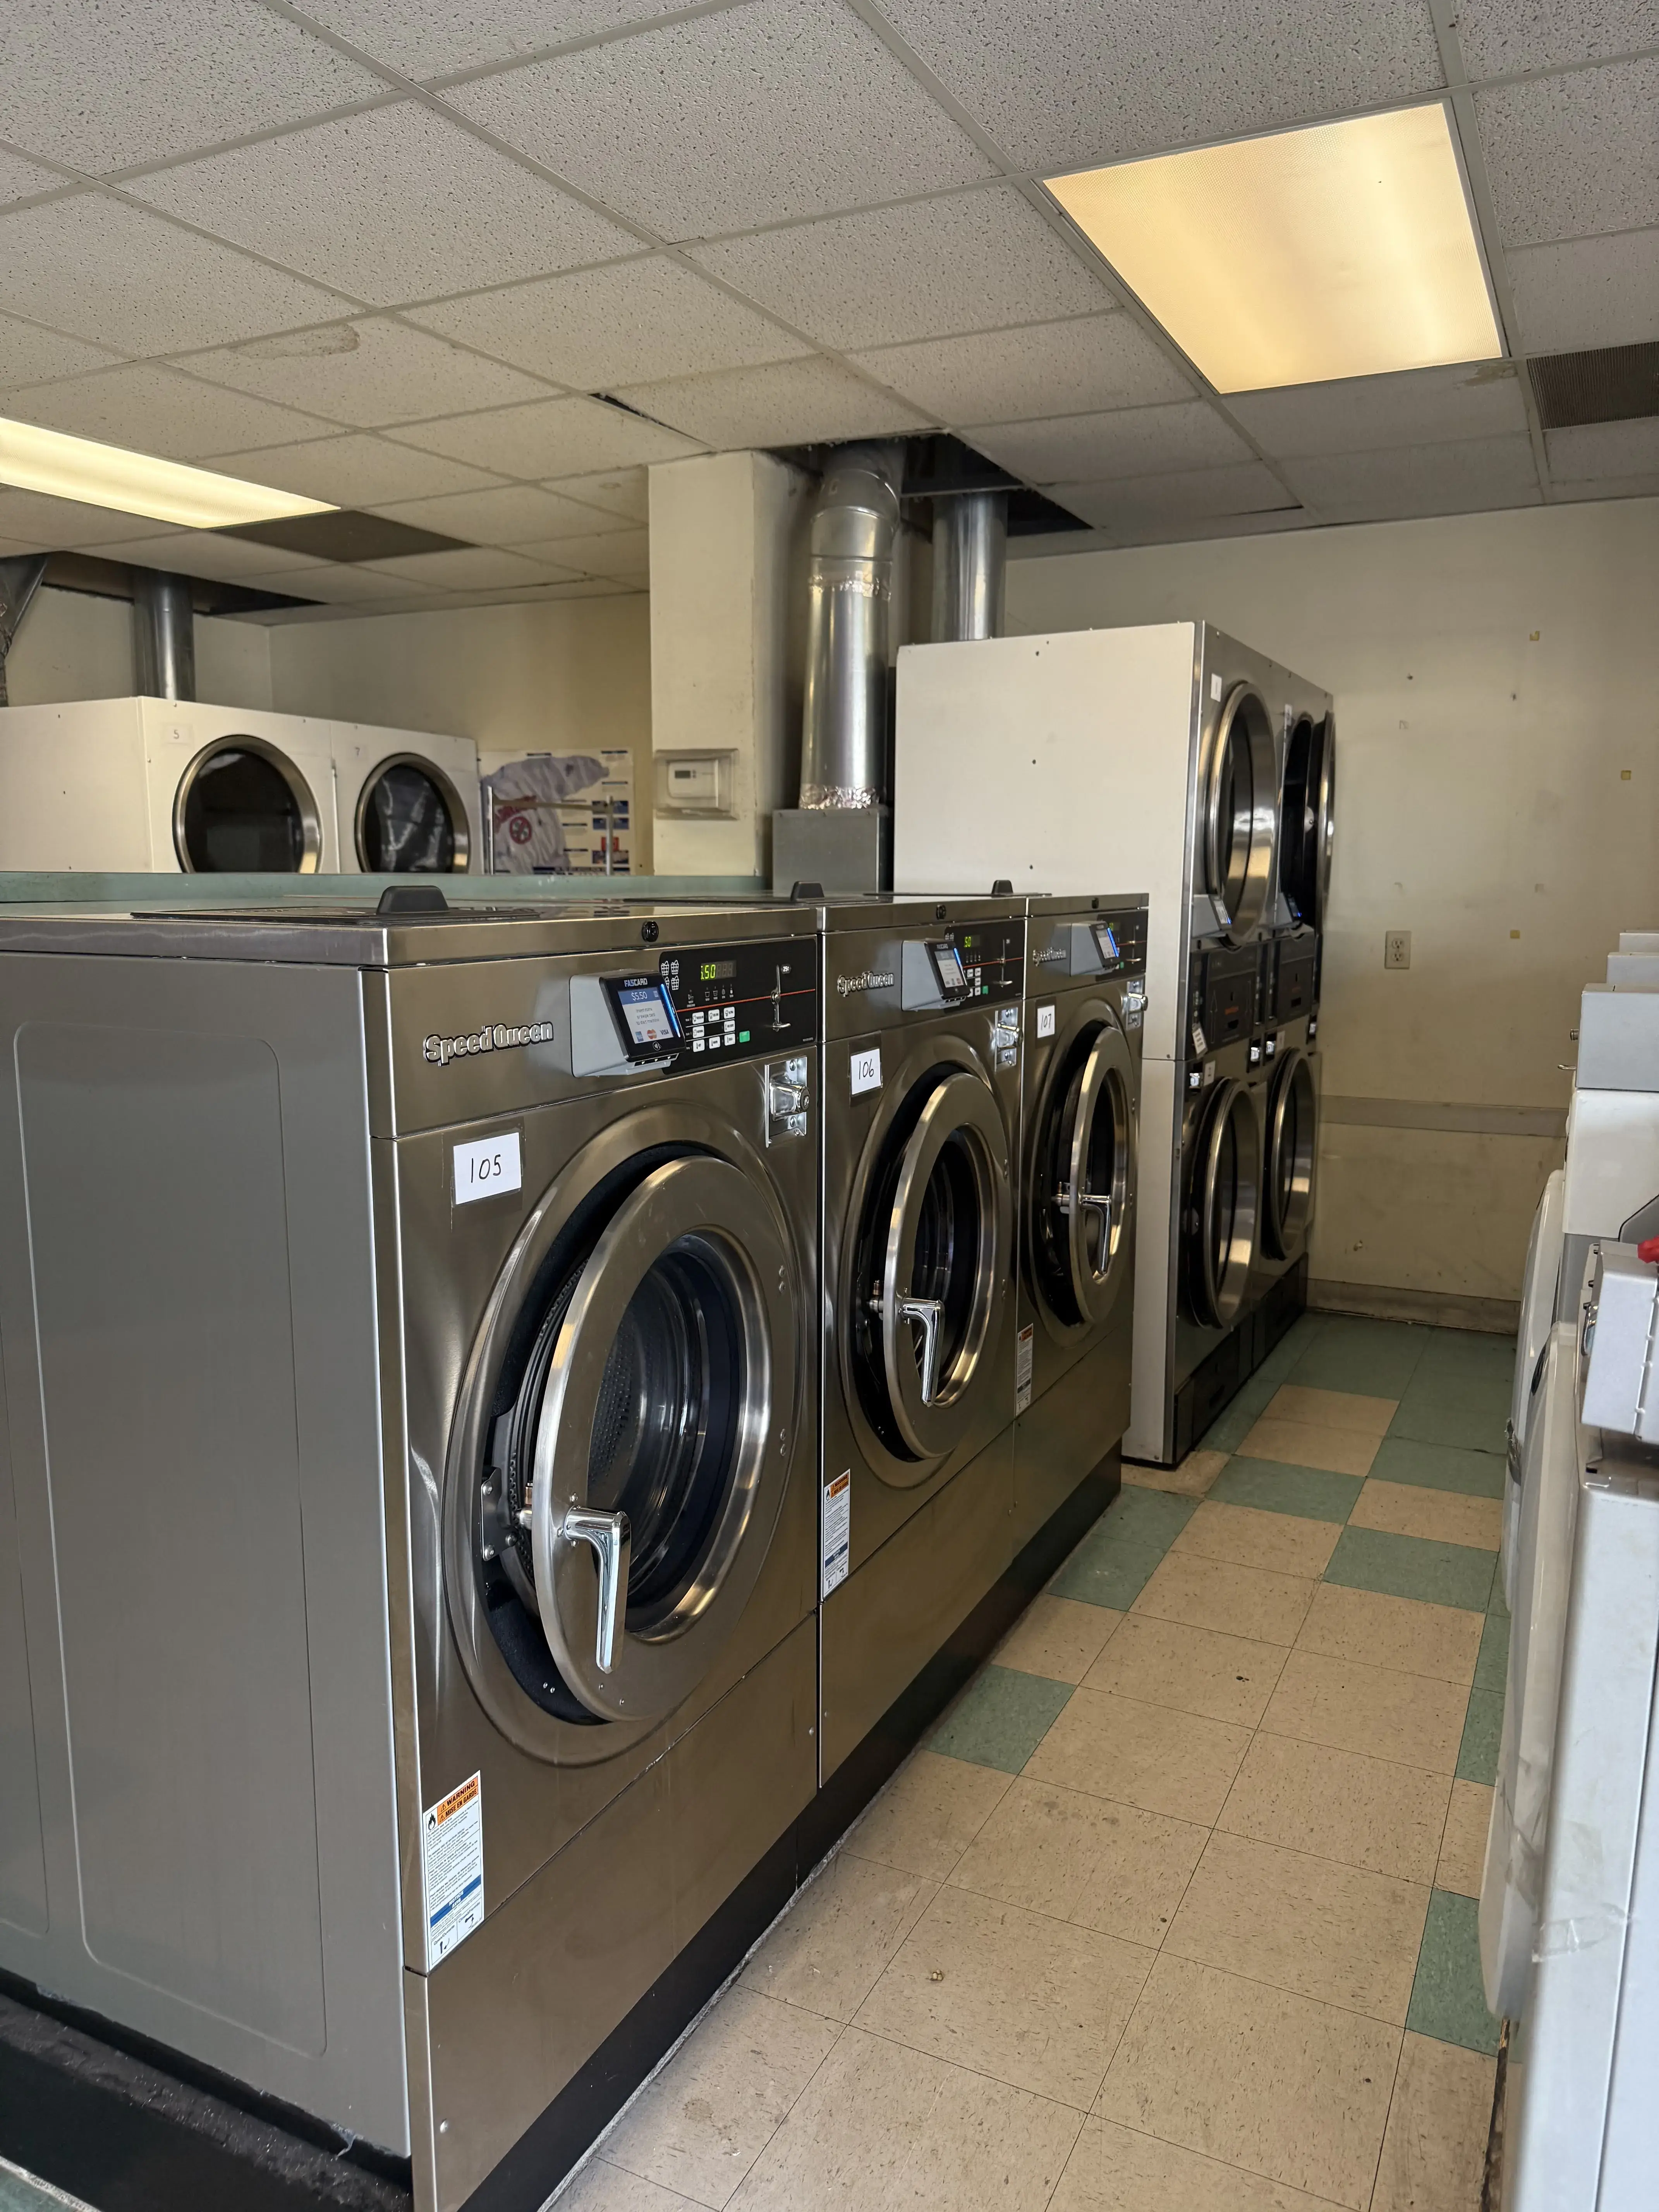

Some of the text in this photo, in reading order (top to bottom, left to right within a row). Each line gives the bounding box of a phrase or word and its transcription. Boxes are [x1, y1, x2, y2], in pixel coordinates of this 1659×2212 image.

[173, 729, 179, 740] 5
[624, 978, 648, 987] FASCARD
[631, 991, 647, 1001] $5.50
[1041, 1013, 1051, 1031] 107
[859, 1058, 874, 1080] 106
[471, 1154, 501, 1183] 105
[447, 1781, 475, 1807] WARNING
